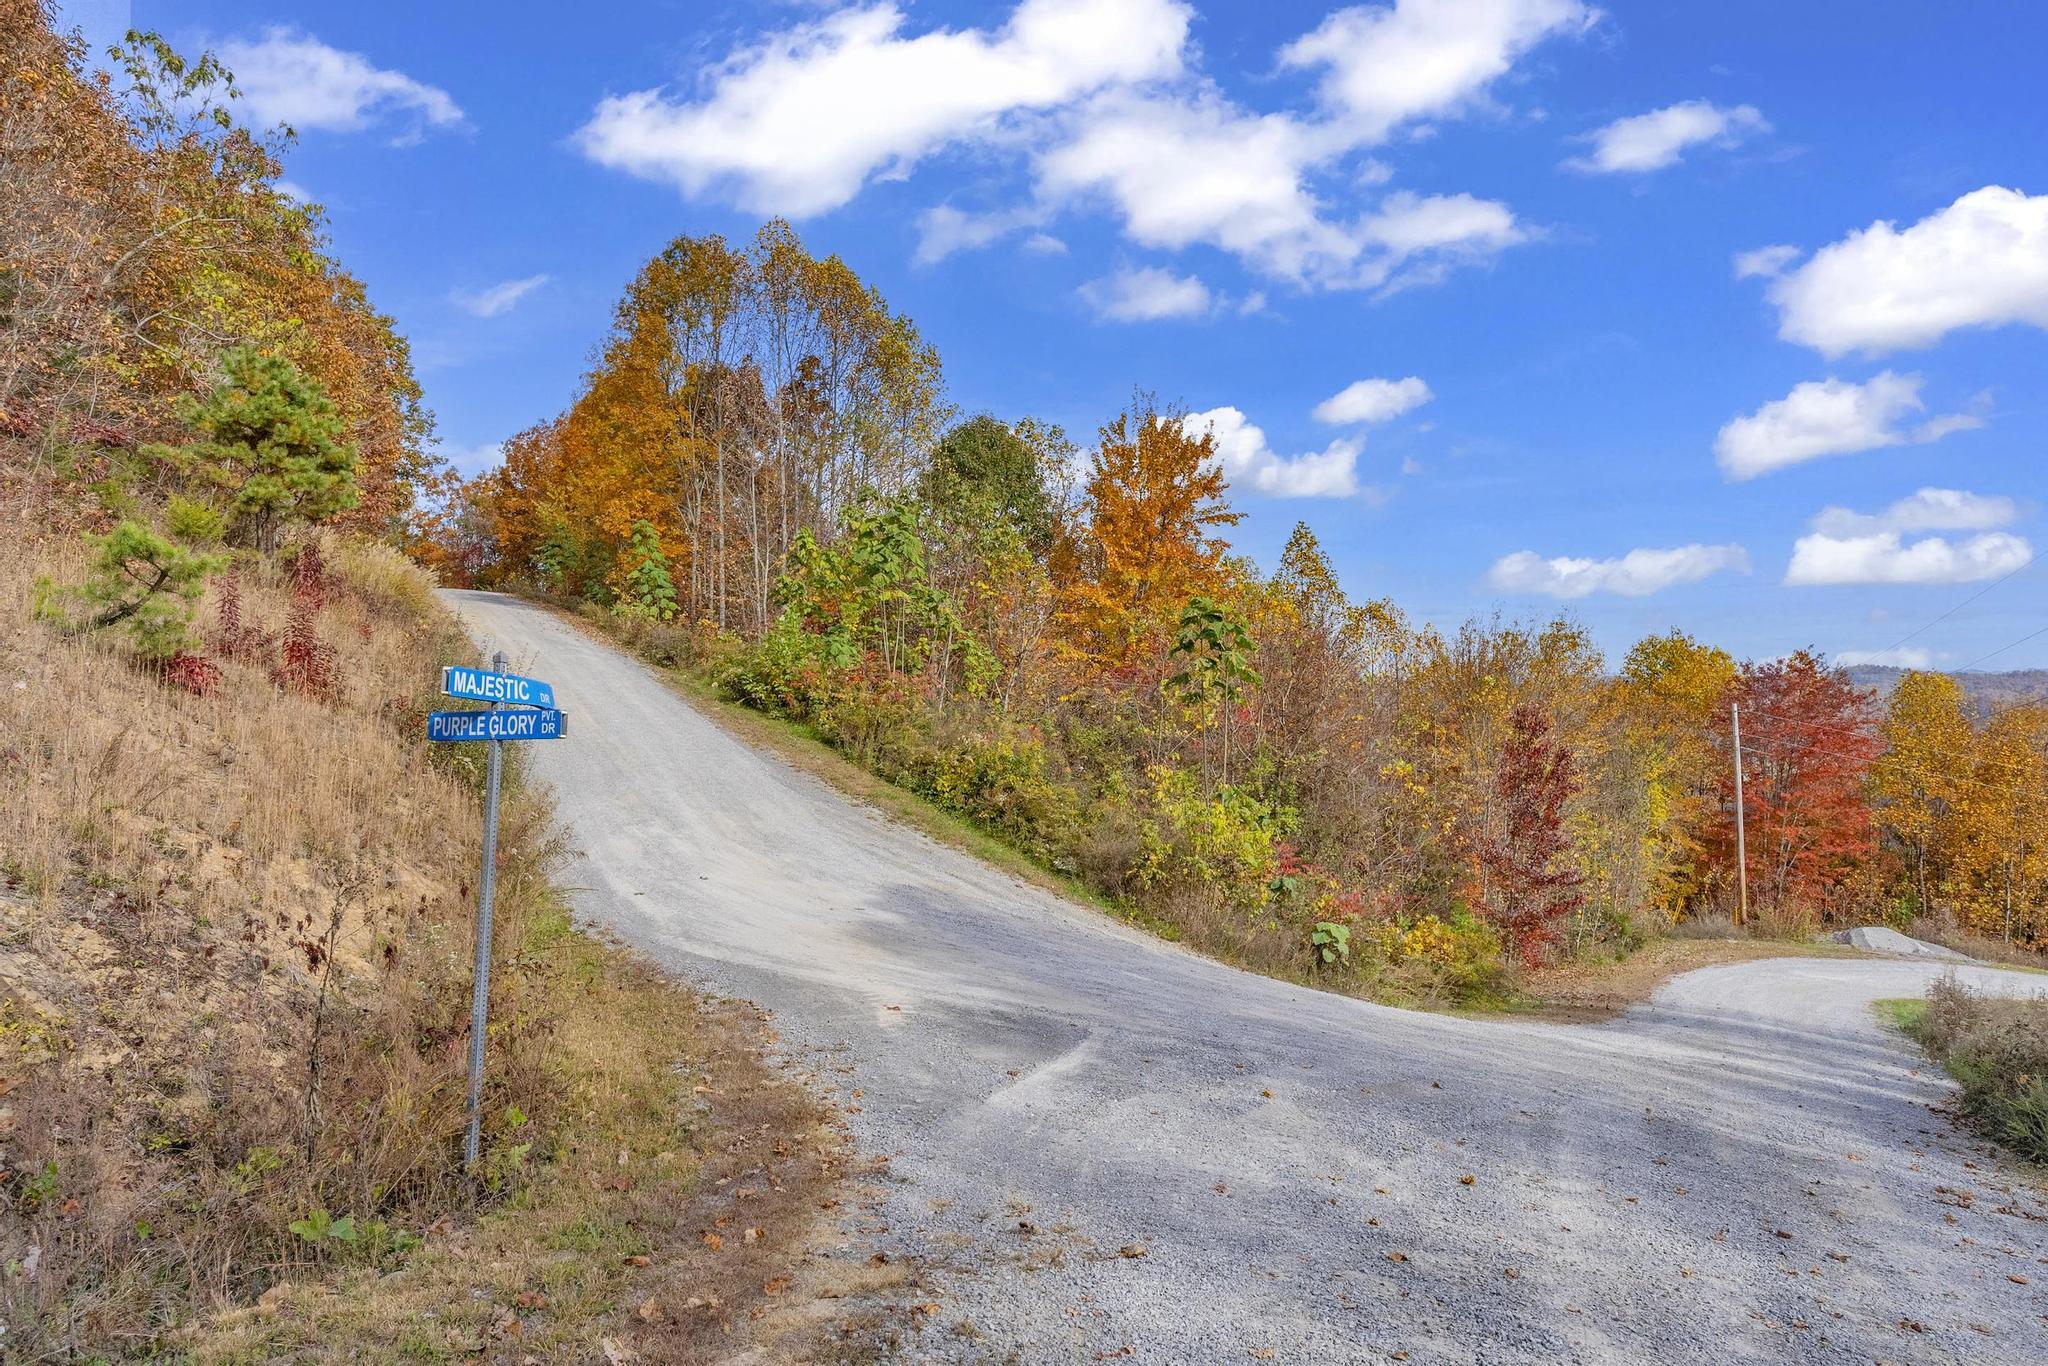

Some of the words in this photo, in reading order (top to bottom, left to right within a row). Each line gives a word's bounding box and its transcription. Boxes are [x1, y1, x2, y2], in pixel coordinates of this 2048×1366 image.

[453, 671, 530, 701] MAJESTIC
[539, 692, 551, 705] DR
[433, 716, 486, 736] PURPLE
[489, 714, 537, 736] GLORY
[541, 723, 555, 734] DR
